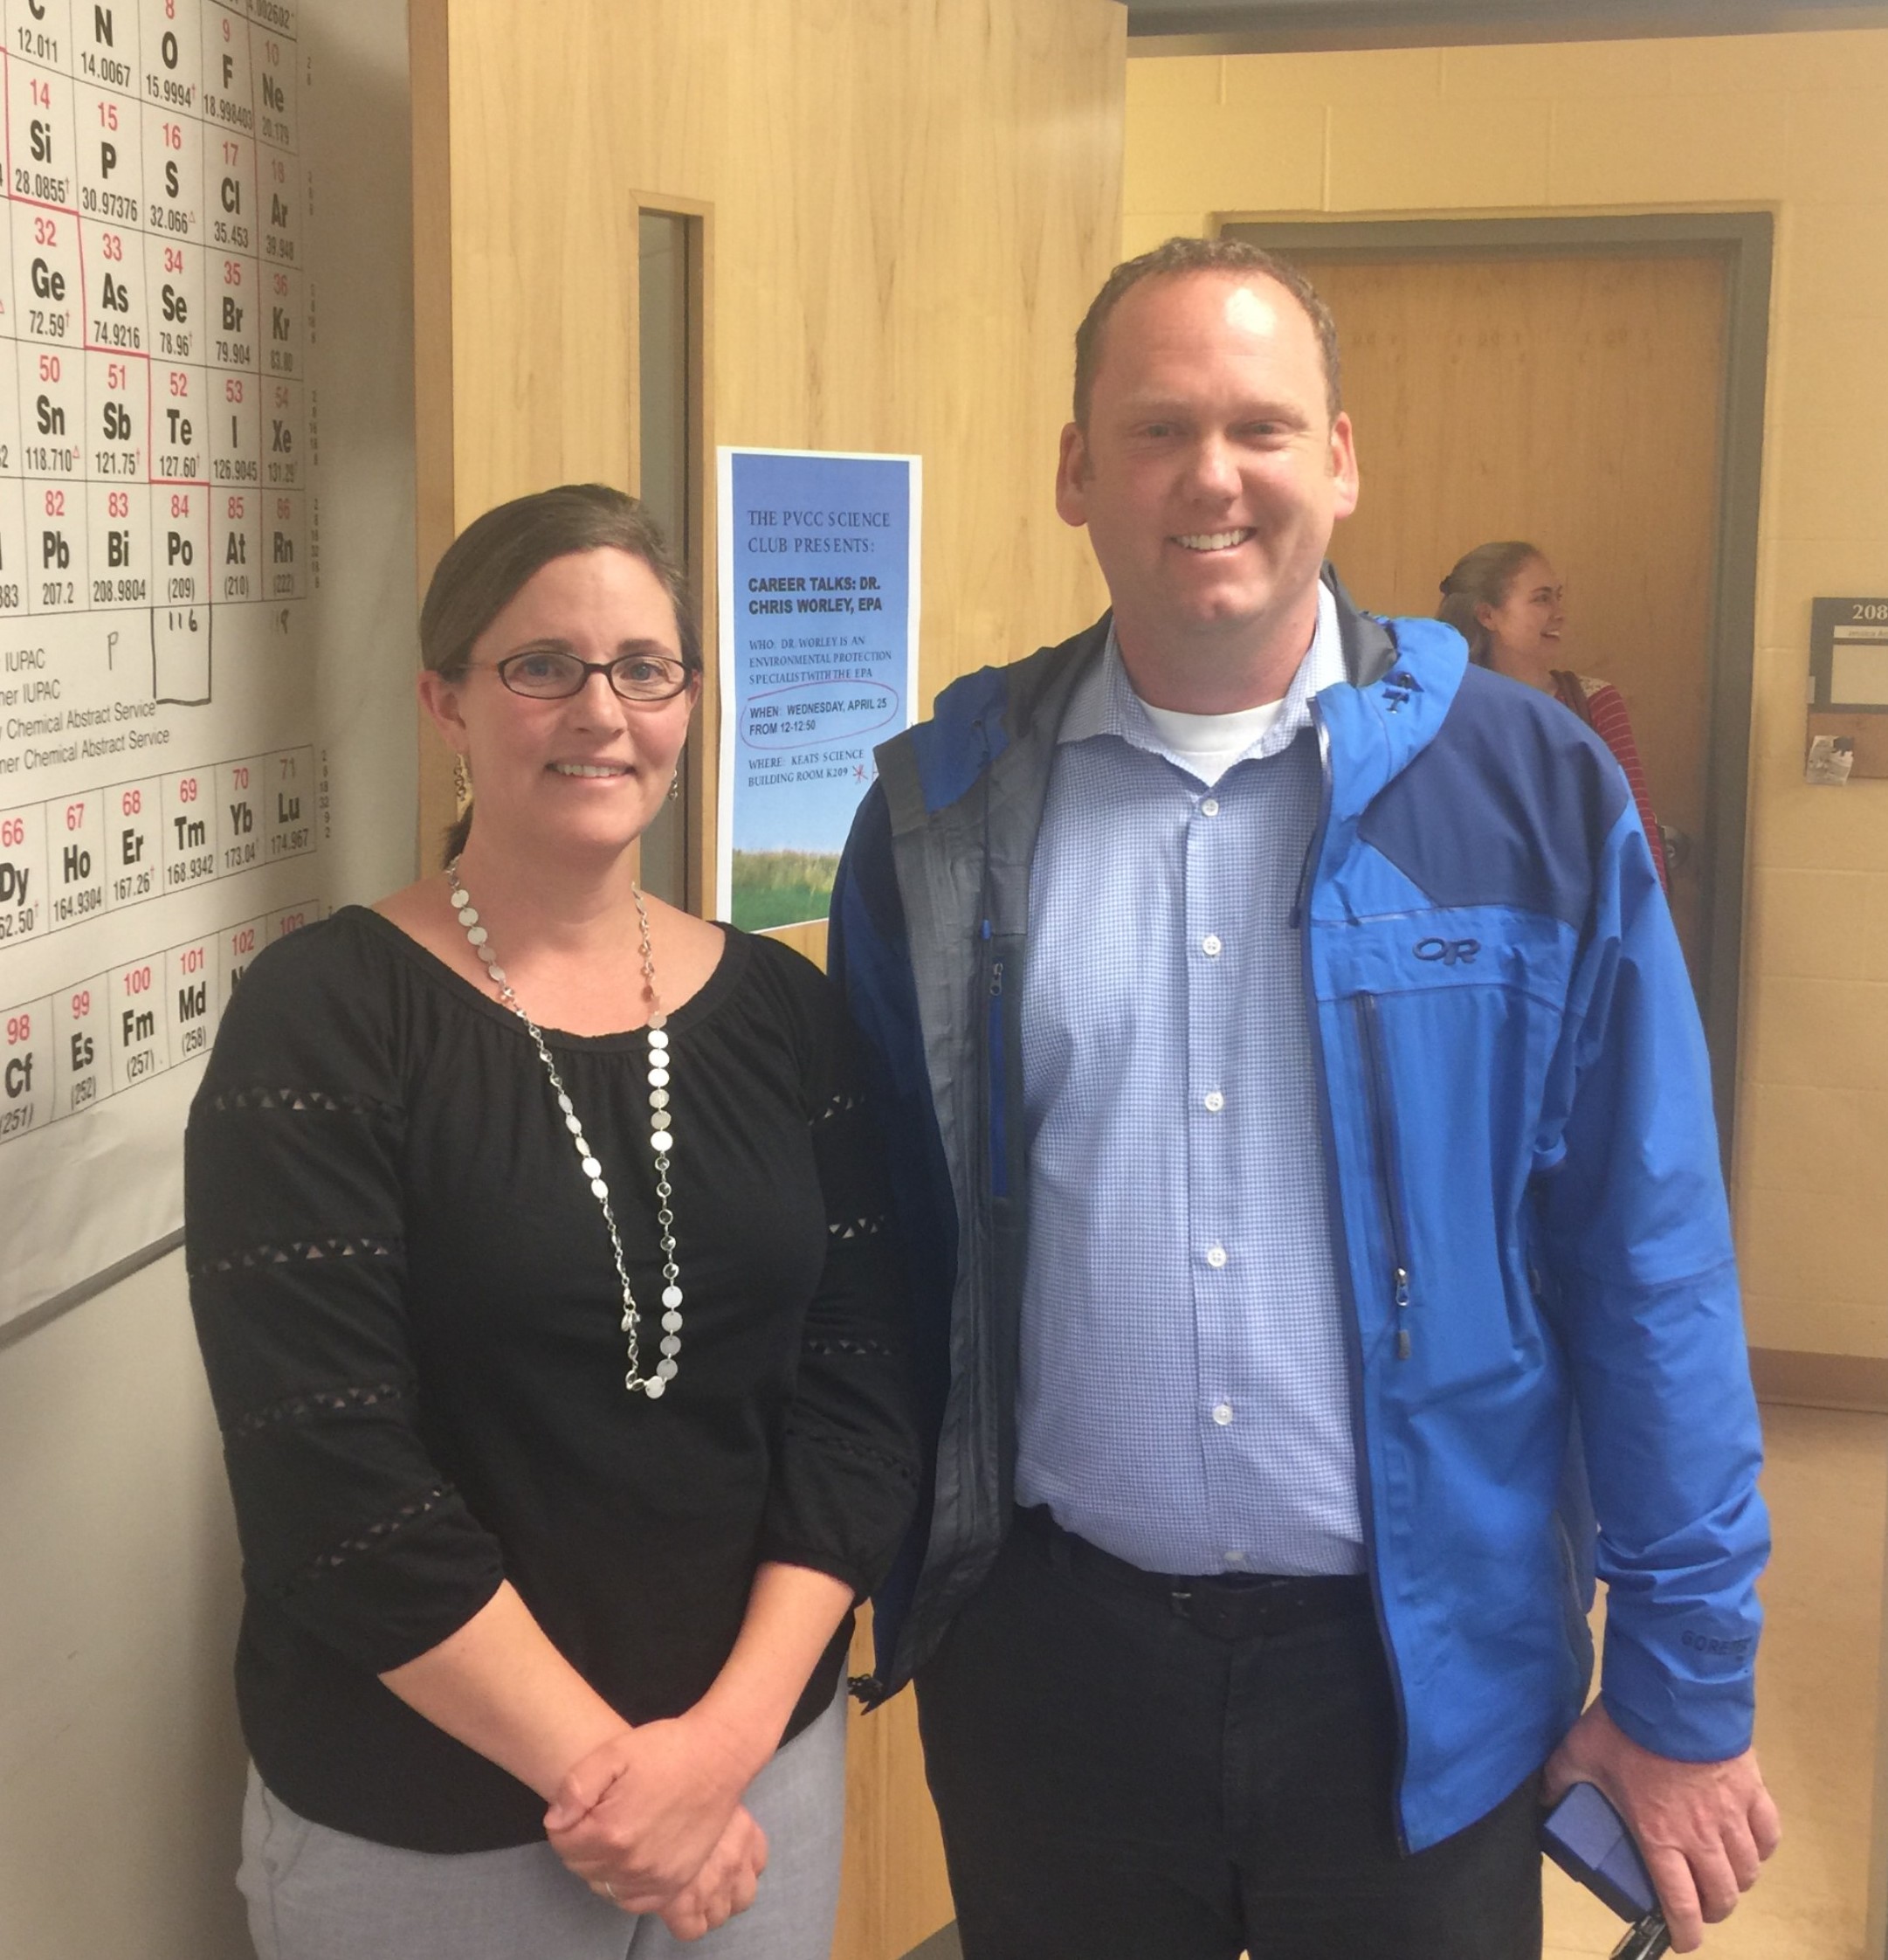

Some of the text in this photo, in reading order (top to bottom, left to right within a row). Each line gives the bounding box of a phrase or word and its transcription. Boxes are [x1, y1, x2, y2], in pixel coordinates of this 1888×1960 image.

[165, 0, 175, 19] 8
[94, 5, 113, 47] N
[223, 18, 231, 42] 9
[18, 27, 58, 63] 12.011
[162, 31, 177, 69] O
[265, 40, 279, 66] 10
[81, 52, 130, 87] 14.0067
[223, 54, 232, 88] F
[30, 79, 51, 109] 14
[263, 72, 284, 113] Ne
[98, 102, 118, 130] 15
[30, 120, 52, 163] Si
[162, 123, 182, 150] 16
[101, 141, 116, 179] P
[223, 142, 238, 166] 17
[166, 161, 179, 198] S
[272, 161, 285, 183] 18
[82, 187, 137, 221] 30.97376
[222, 177, 240, 214] Cl
[272, 193, 287, 228] Ar
[34, 217, 57, 246] 32
[214, 221, 248, 248] 35.453
[103, 233, 121, 261] 33
[164, 247, 183, 273] 34
[31, 258, 65, 300] Ge
[224, 261, 241, 286] 35
[273, 273, 287, 296] 36
[103, 273, 128, 313] As
[162, 284, 187, 322] Se
[223, 296, 243, 332] Br
[272, 307, 289, 342] Kr
[94, 321, 140, 349] 74.9216
[217, 341, 250, 365] 79.904
[39, 355, 60, 383] 50
[107, 363, 126, 390] 51
[169, 372, 187, 397] 52
[225, 379, 243, 404] 53
[274, 387, 288, 408] 54
[37, 394, 65, 436] Sn
[103, 401, 131, 440] Sb
[167, 409, 192, 445] Te
[232, 416, 238, 448] I
[272, 420, 292, 453] Xe
[213, 459, 257, 480] 126.9045
[45, 490, 65, 516] 82
[108, 493, 128, 517] 83
[171, 494, 189, 518] 84
[228, 497, 244, 519] 85
[748, 511, 890, 527] THE PVCC SCIENCE
[44, 531, 69, 569] Pb
[108, 530, 129, 568] Bi
[168, 531, 193, 566] Po
[226, 532, 245, 564] At
[273, 532, 293, 563] Rn
[748, 538, 874, 553] CLUB PRESENTS:
[43, 583, 73, 604] 207.2
[93, 580, 146, 602] 208.9804
[168, 577, 195, 602] (209)
[224, 576, 249, 598] (210)
[748, 576, 880, 592] CAREER TALKS: DR.
[169, 609, 197, 631] 116
[749, 597, 882, 615] CHRIS WORLEY, EPA
[1852, 604, 1888, 620] 208
[799, 637, 837, 648] WORLEY
[840, 637, 847, 646] IS
[851, 636, 865, 645] AN
[5, 648, 45, 672] IUPAC
[833, 651, 892, 666] PROTECTION
[833, 669, 851, 680] THE
[855, 668, 872, 678] EPA
[23, 679, 60, 703] IUPAC
[7, 712, 62, 739] Chemical
[67, 707, 111, 729] Abstract
[114, 700, 155, 721] Service
[787, 701, 845, 716] WEDNESDAY,
[848, 700, 874, 712] APRIL
[878, 698, 886, 708] 25
[750, 720, 816, 735] FROM 12-12:50
[24, 742, 77, 770] Chemical
[82, 735, 125, 759] Abstract
[129, 728, 169, 749] Service
[791, 753, 819, 766] KEATS
[823, 749, 864, 763] SCIENCE
[232, 767, 249, 791] 70
[280, 757, 296, 779] 71
[748, 768, 848, 787] BUILDING ROOM K209
[122, 790, 141, 817] 68
[180, 778, 196, 803] 69
[66, 803, 84, 832] 67
[230, 803, 252, 835] Yb
[278, 793, 300, 825] Lu
[2, 818, 24, 848] 66
[122, 829, 143, 866] Er
[175, 816, 205, 851] Tm
[272, 828, 308, 854] 174.967
[63, 845, 90, 884] Ho
[168, 855, 213, 886] 168.9342
[0, 863, 29, 907] Dy
[54, 887, 101, 922] 164.9304
[0, 908, 33, 941] 62.50
[232, 929, 255, 956] 102
[1413, 937, 1481, 965] OR
[180, 948, 204, 976] 101
[124, 967, 150, 997] 100
[72, 990, 89, 1020] 99
[179, 982, 206, 1023] Md
[7, 1015, 30, 1046] 98
[122, 1010, 154, 1047] Fm
[182, 1025, 206, 1057] (258)
[71, 1032, 93, 1072] Es
[127, 1050, 155, 1082] (257)
[5, 1053, 32, 1099] Cf
[71, 1076, 96, 1111] (252)
